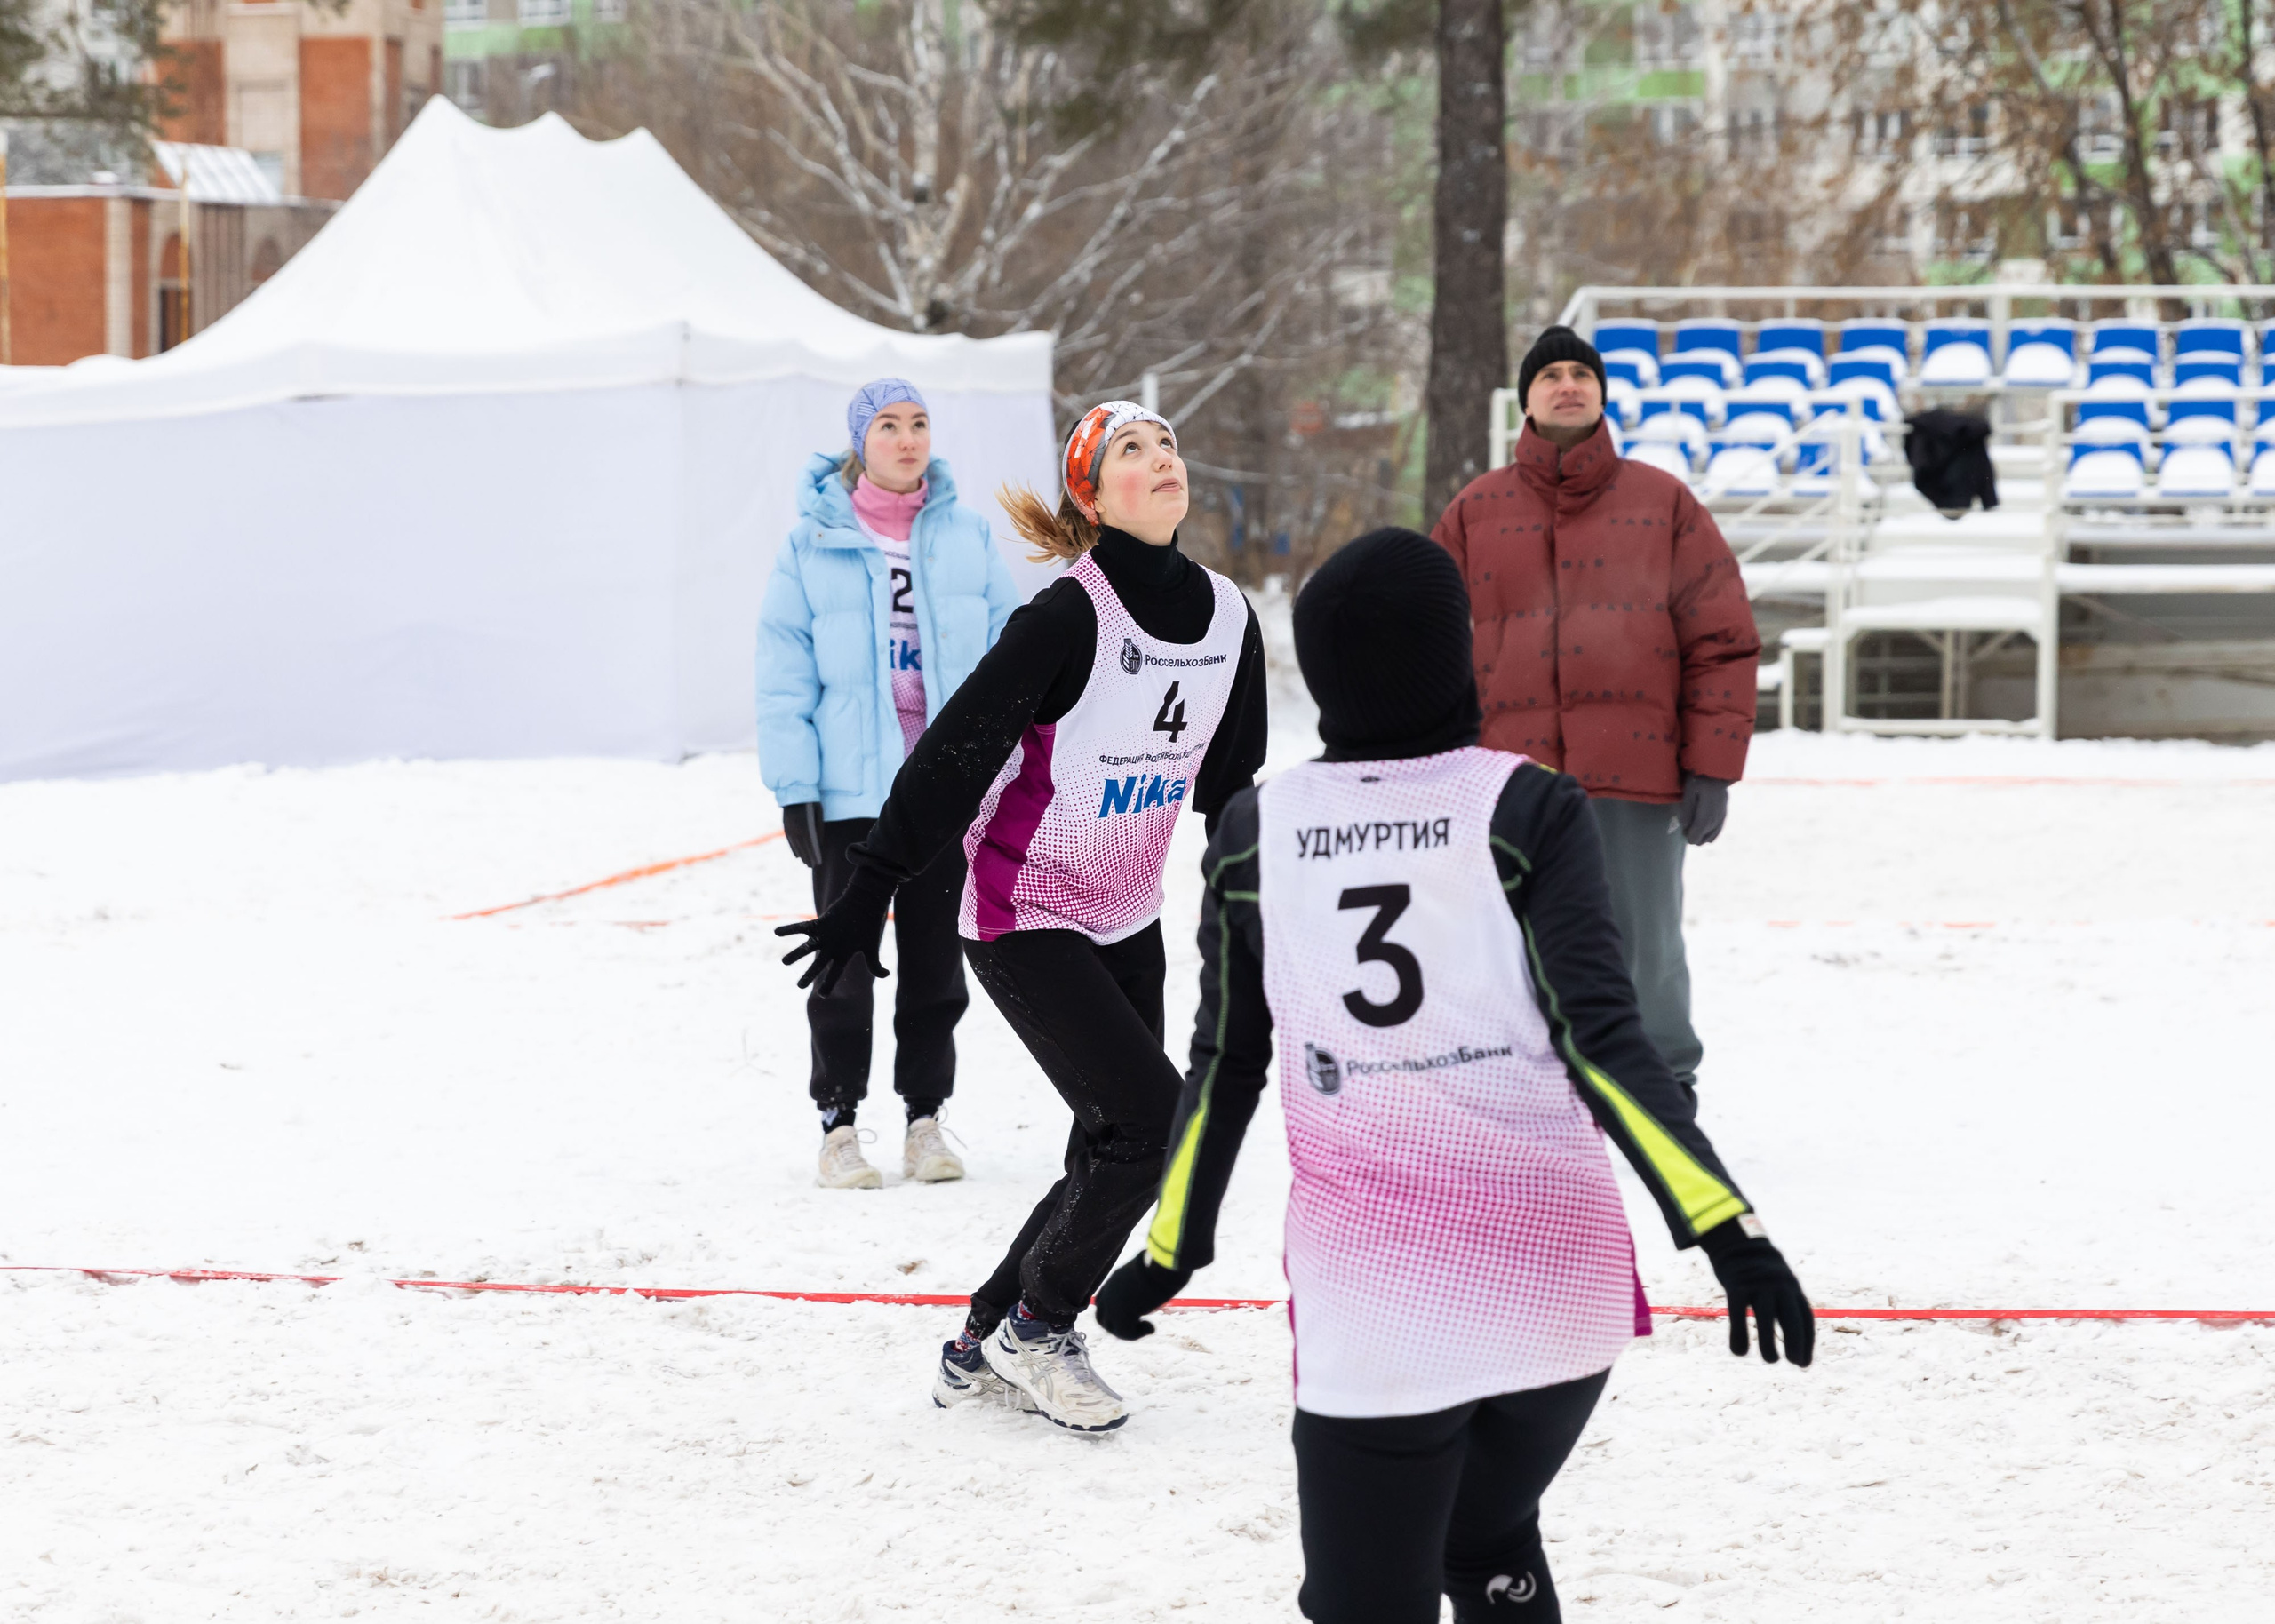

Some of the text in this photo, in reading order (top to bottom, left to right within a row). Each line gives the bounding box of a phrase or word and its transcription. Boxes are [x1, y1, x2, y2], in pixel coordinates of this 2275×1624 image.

[890, 567, 914, 613] 2
[890, 639, 922, 671] ik
[1153, 681, 1188, 744] 4
[1297, 818, 1450, 859] УДМУРТИЯ
[1337, 883, 1424, 1028] 3
